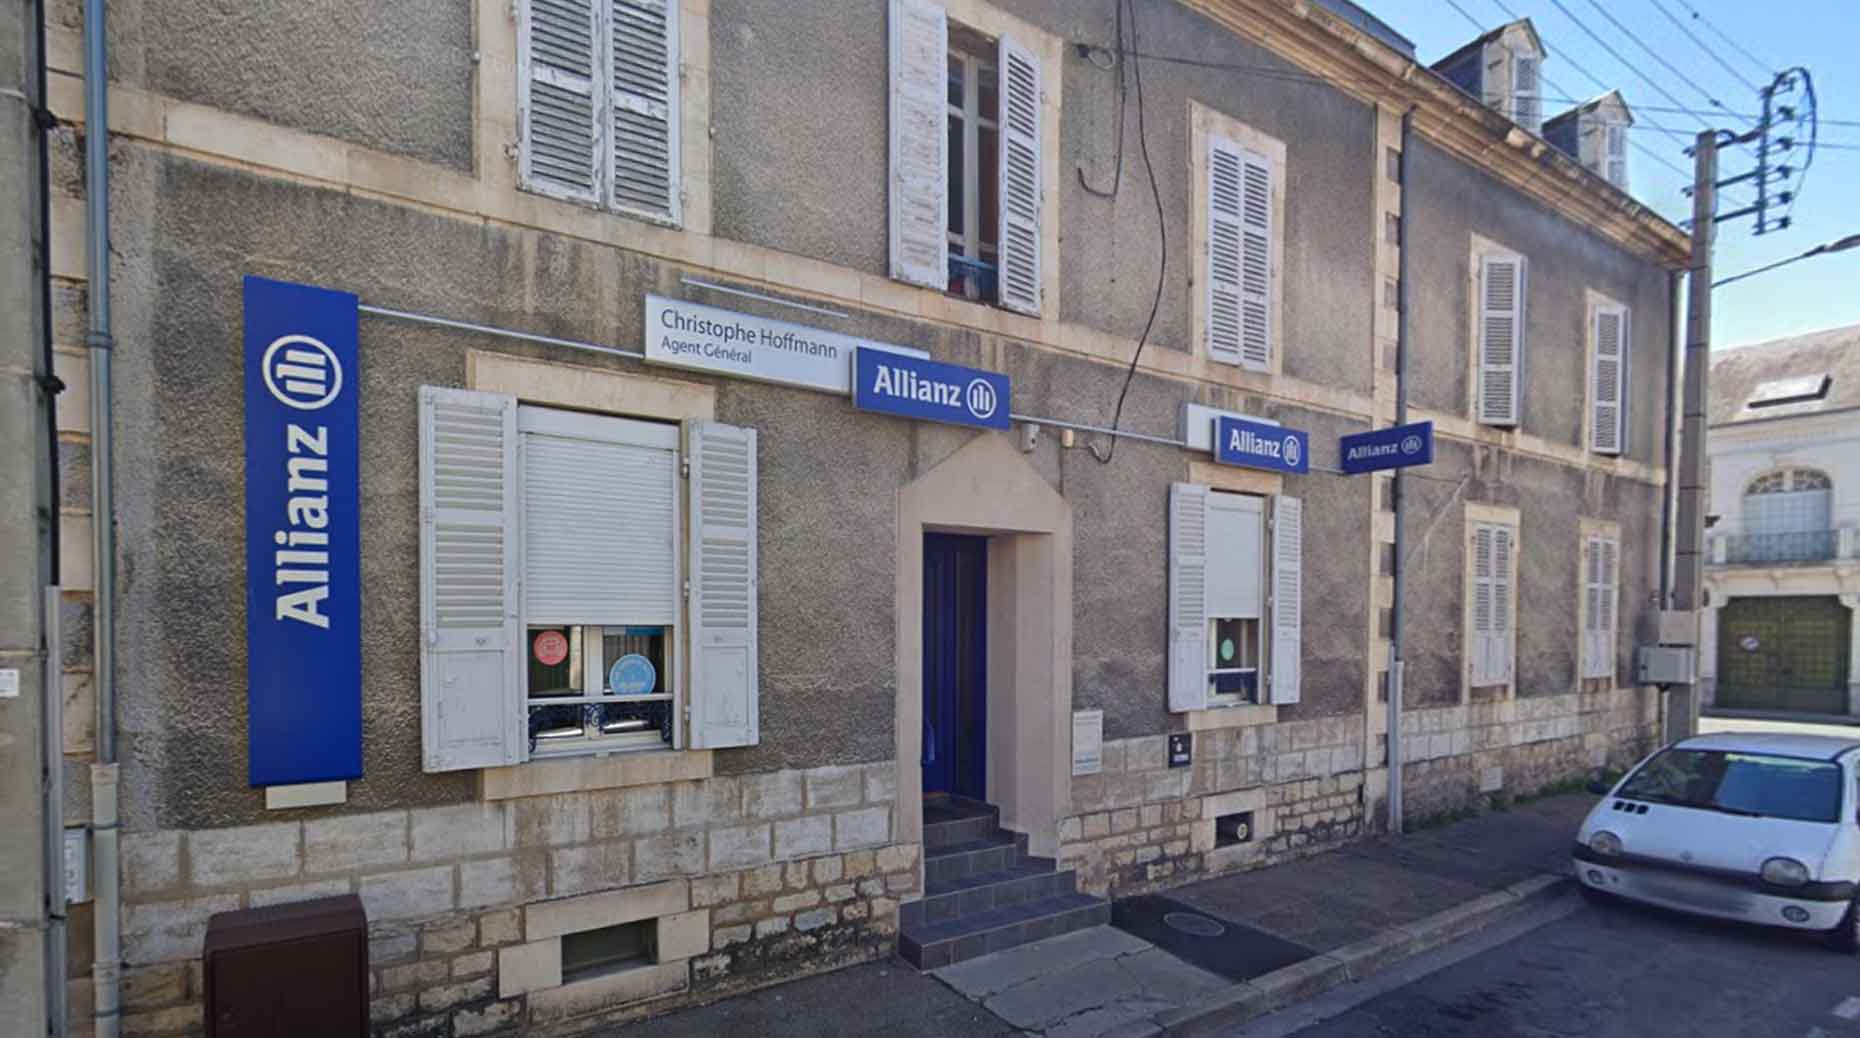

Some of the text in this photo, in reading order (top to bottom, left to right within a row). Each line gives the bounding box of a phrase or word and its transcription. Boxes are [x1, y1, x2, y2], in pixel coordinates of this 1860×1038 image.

[661, 309, 838, 360] Christophe Hoffmann
[661, 338, 752, 364] Agent Général
[873, 365, 961, 408] Allianz
[1229, 428, 1281, 458] Allianz
[1347, 442, 1399, 460] Allianz
[274, 423, 331, 631] Allianz
